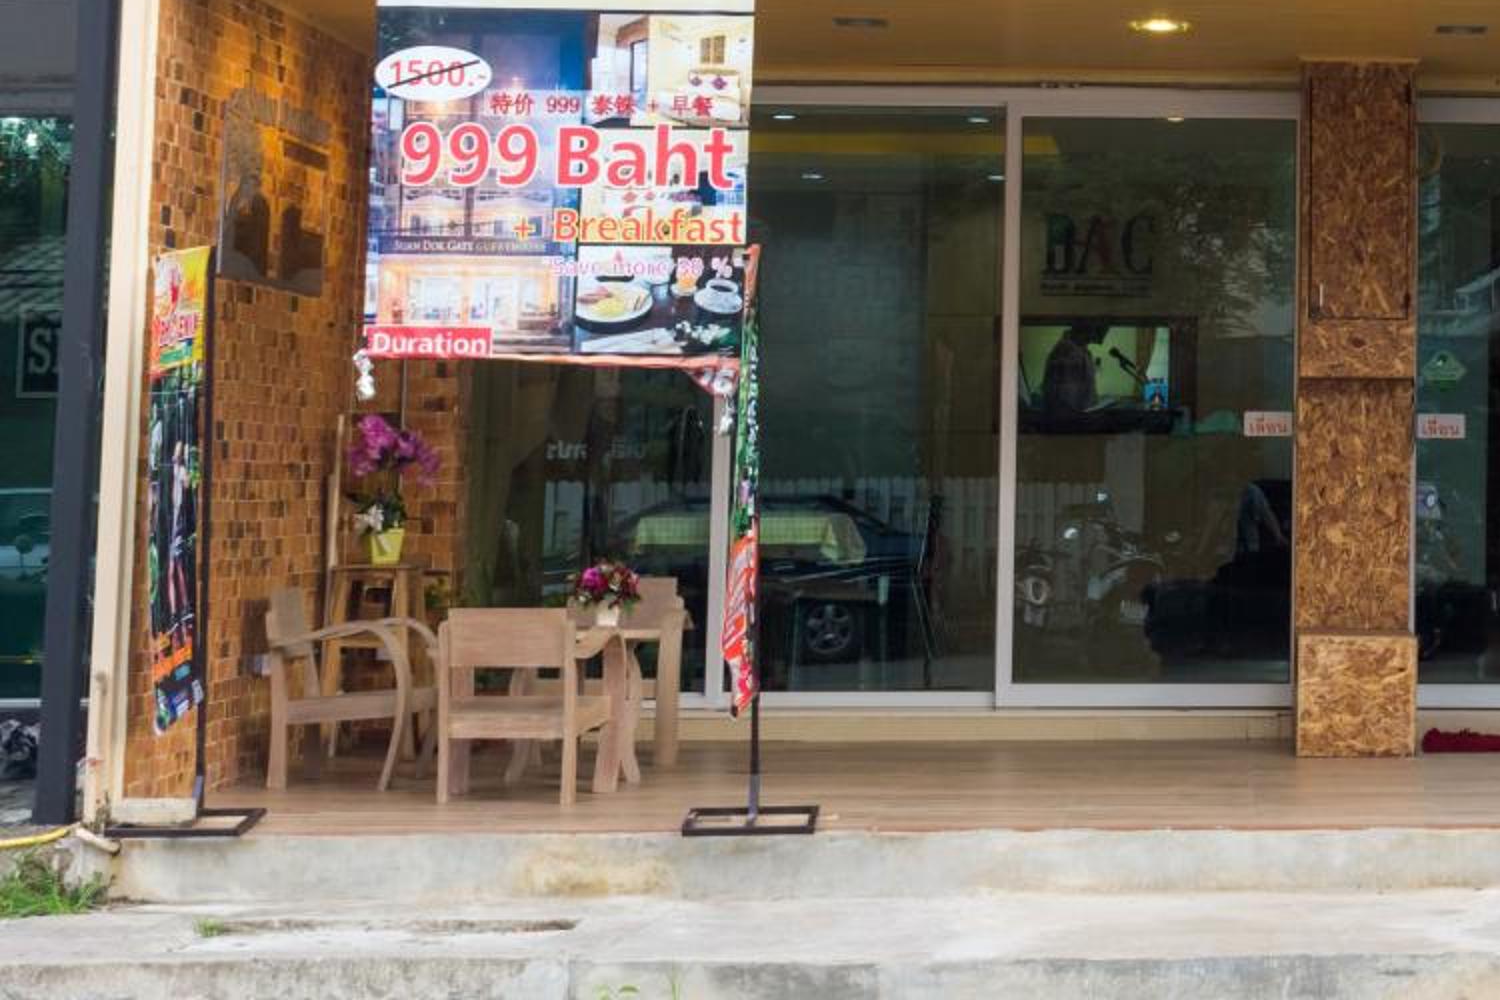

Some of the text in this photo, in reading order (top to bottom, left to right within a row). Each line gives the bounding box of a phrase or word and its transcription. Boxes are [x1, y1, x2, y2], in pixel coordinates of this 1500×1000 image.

[489, 95, 535, 117] 特价
[545, 97, 581, 115] 999
[671, 95, 715, 117] 早餐
[401, 122, 737, 189] 999 Baht
[554, 207, 744, 243] Breakfast
[371, 331, 488, 355] Duration
